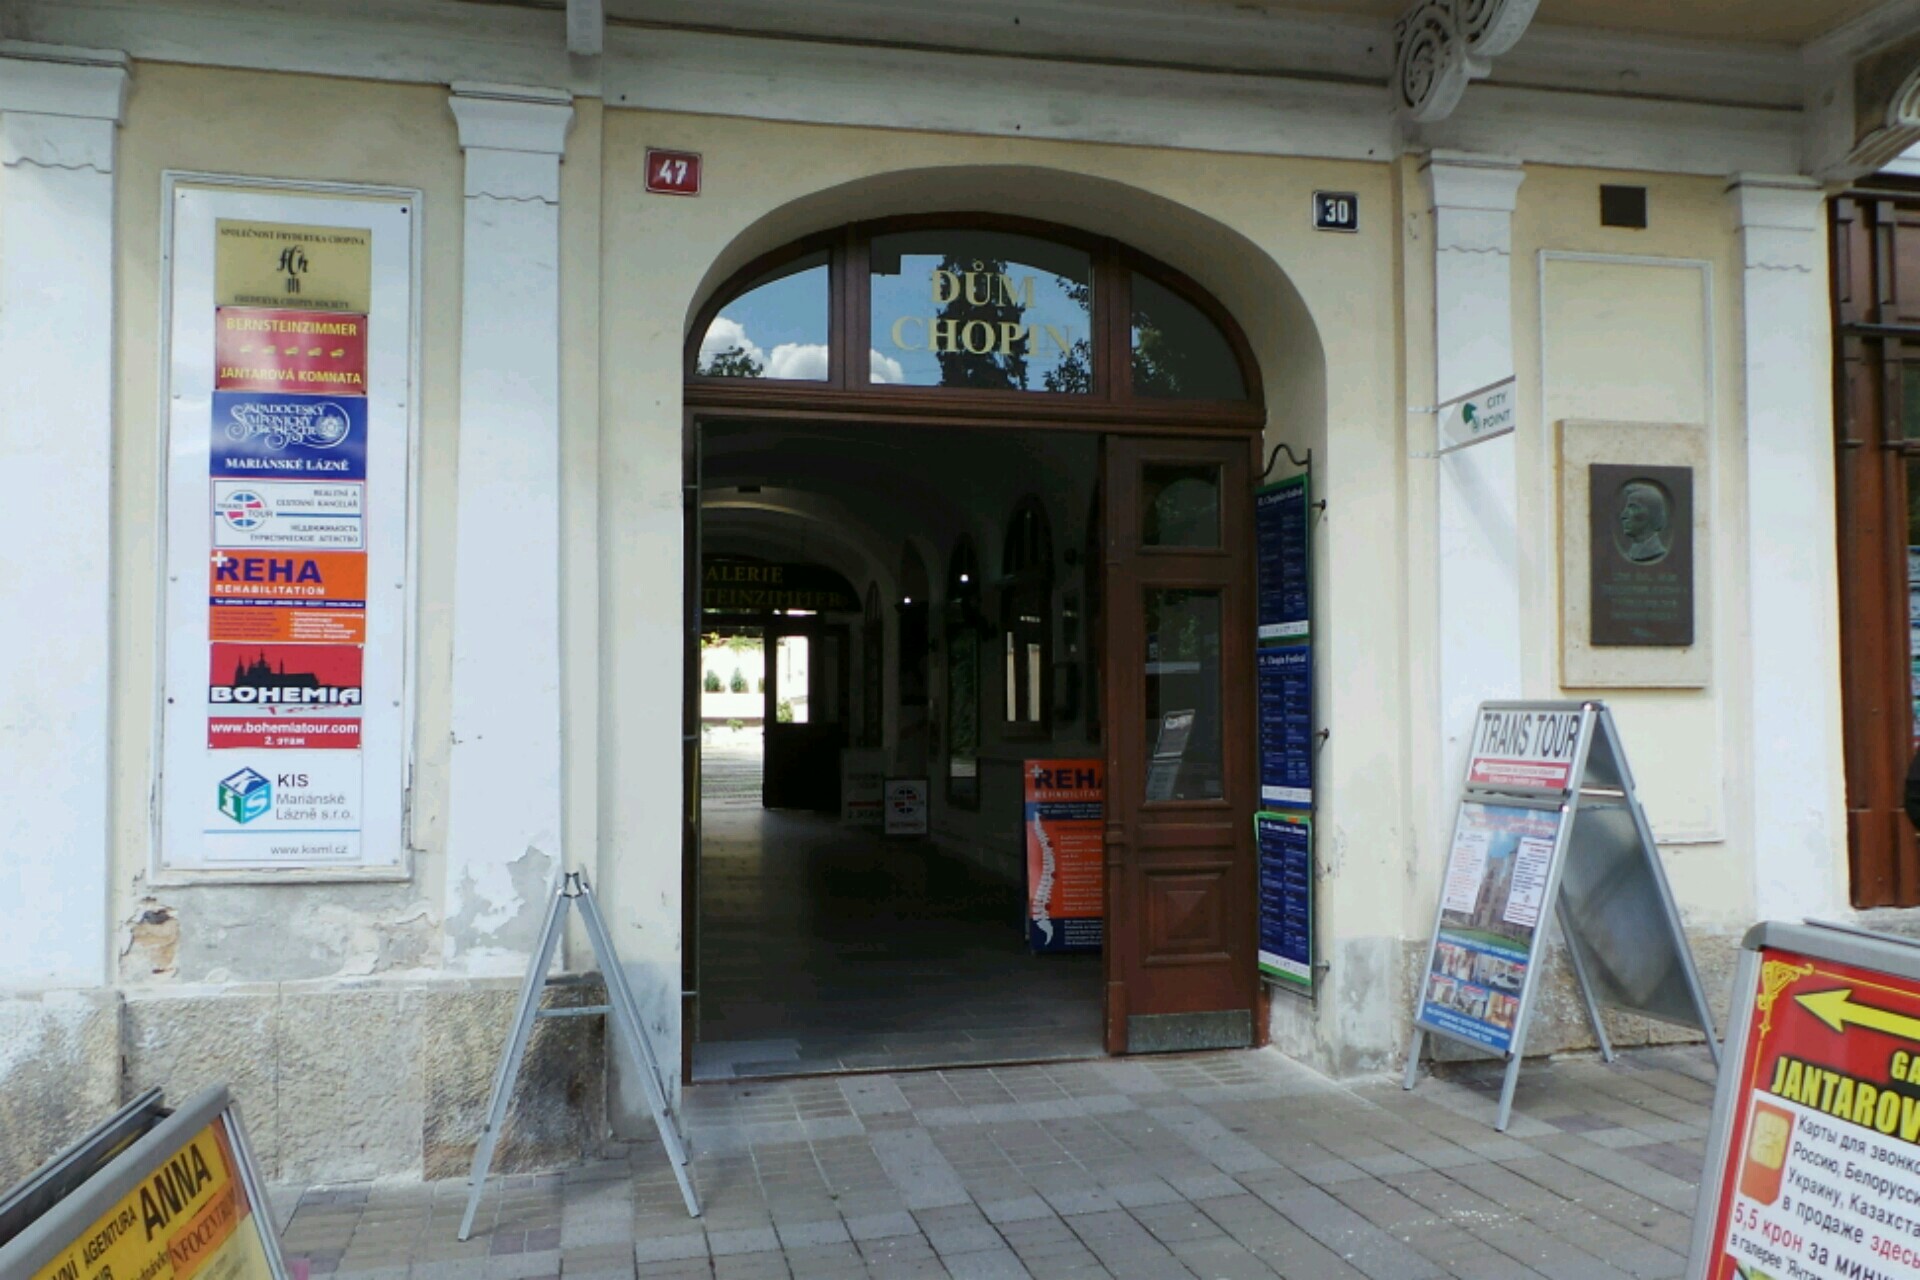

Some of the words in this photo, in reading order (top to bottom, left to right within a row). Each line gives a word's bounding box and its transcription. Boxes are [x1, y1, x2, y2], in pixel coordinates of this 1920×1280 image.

[660, 160, 688, 184] 47
[1325, 199, 1348, 223] 30
[929, 260, 1037, 309] DŮM
[226, 317, 357, 336] BERNSTEINZIMMER
[892, 315, 1073, 359] CHOPIN
[220, 366, 295, 382] JANTAROVÁ
[297, 369, 362, 385] KOMNATA
[1486, 391, 1507, 410] CITY
[1482, 408, 1511, 429] POINT
[225, 456, 304, 470] MARIÁNSKÉ
[305, 458, 350, 472] LÁZNĚ
[215, 558, 323, 583] REHA
[215, 584, 325, 595] REHABILITATION
[210, 686, 361, 704] BOHEMIA
[211, 722, 358, 734] www.bohemiatour.com
[1479, 713, 1532, 756] TRANS
[1533, 714, 1581, 758] TOUR
[264, 736, 274, 745] 2.
[278, 774, 309, 788] KIS
[1035, 768, 1103, 790] REH
[276, 793, 346, 805] Mariánské
[276, 808, 317, 820] Lázně
[321, 810, 354, 820] s.r.o.
[1798, 1113, 1838, 1144] Карты
[1839, 1135, 1867, 1155] для
[1793, 1141, 1841, 1178] Россию,
[139, 1143, 213, 1242] ANNA
[1787, 1166, 1844, 1209] Украину,
[83, 1205, 138, 1269] AGENTURA
[1734, 1202, 1759, 1231] 5,5
[1762, 1219, 1803, 1250] крон
[1808, 1242, 1829, 1266] за
[1781, 1196, 1791, 1212] в
[1796, 1202, 1864, 1244] продаже
[1870, 1235, 1920, 1270] здесь
[1739, 1238, 1783, 1270] галерее
